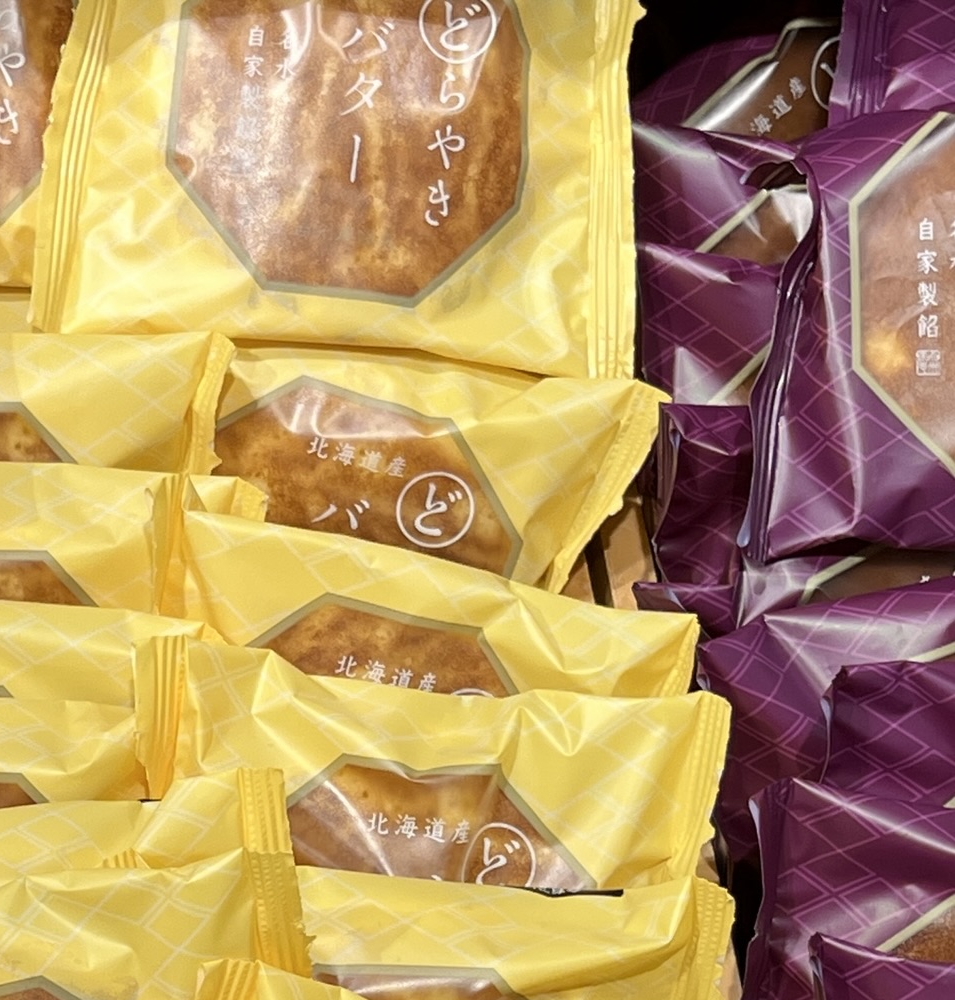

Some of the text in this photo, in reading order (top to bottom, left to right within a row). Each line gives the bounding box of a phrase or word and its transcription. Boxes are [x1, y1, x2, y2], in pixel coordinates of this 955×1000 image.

[340, 20, 395, 184] バター
[424, 2, 482, 227] どらやき
[916, 217, 939, 338] 自家製餡
[307, 436, 407, 479] 北海道産
[311, 499, 371, 531] バ
[367, 812, 471, 845] 北海道産
